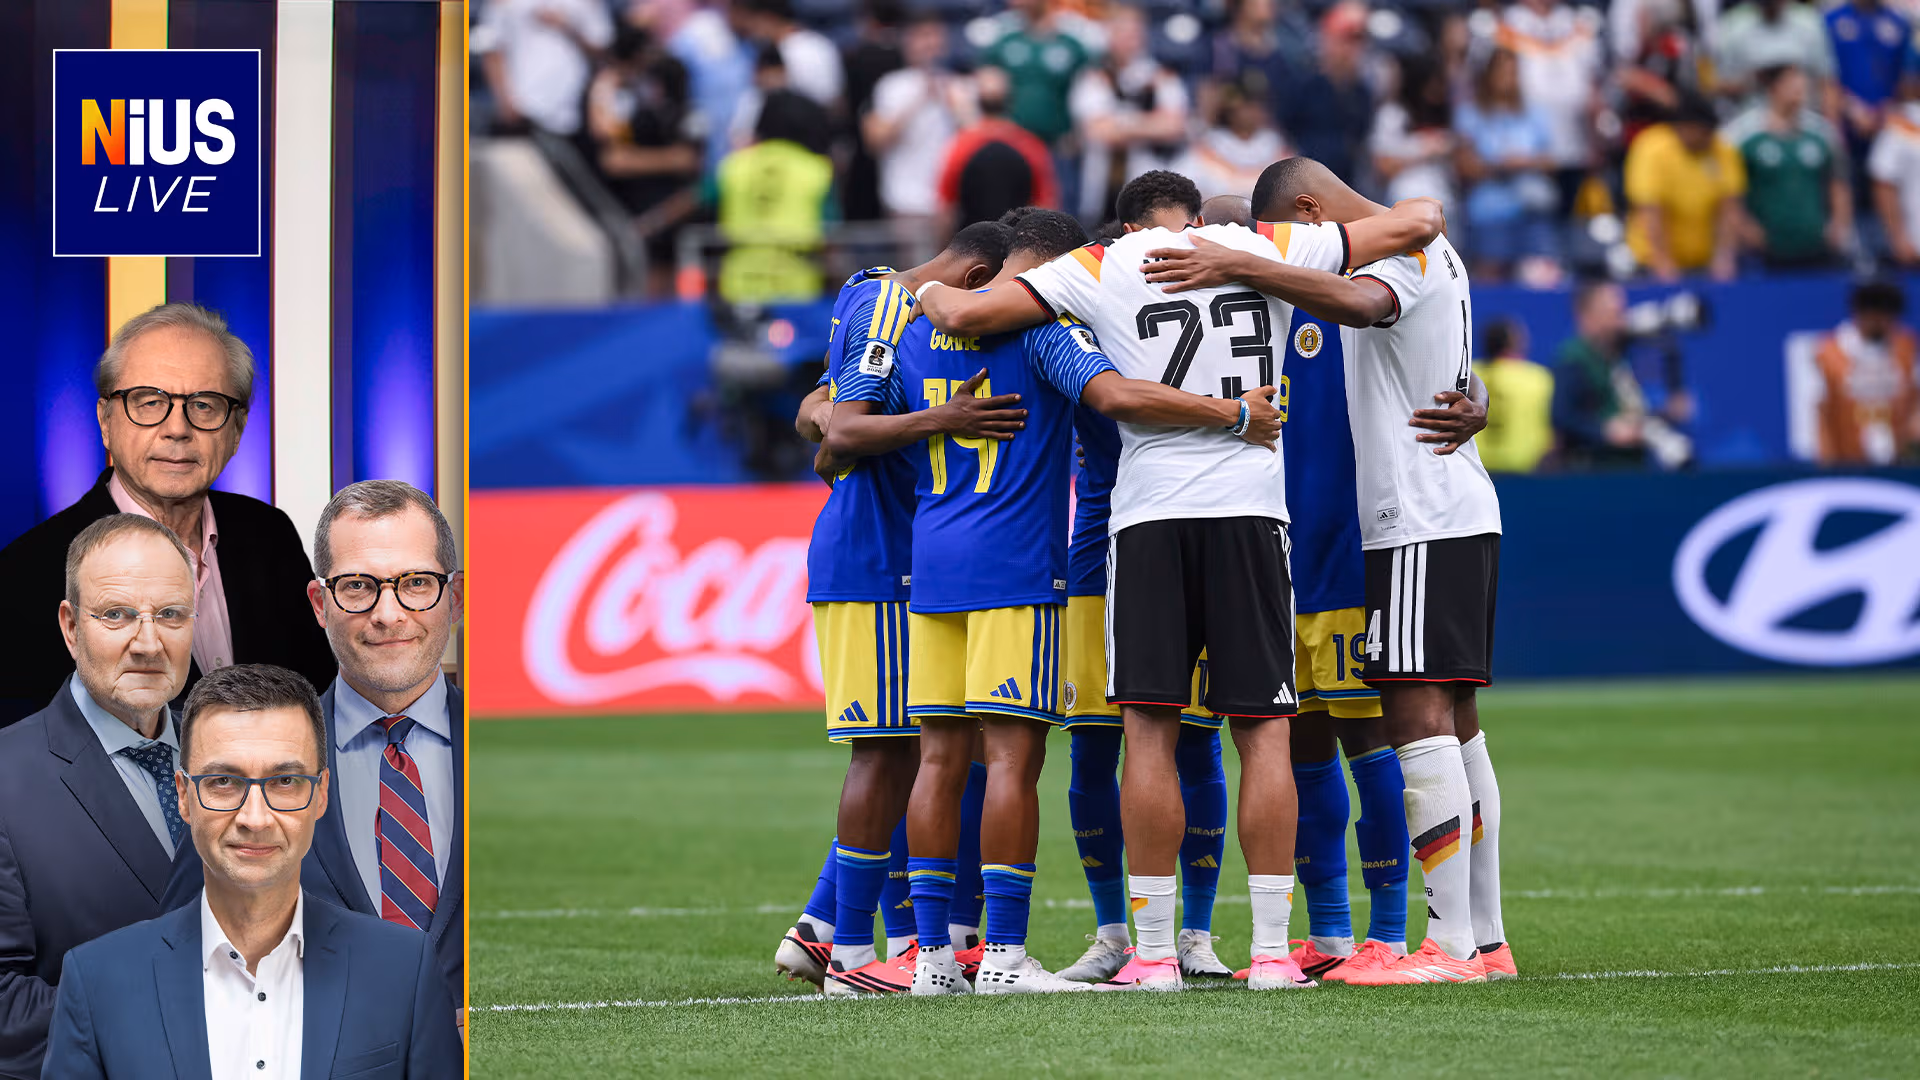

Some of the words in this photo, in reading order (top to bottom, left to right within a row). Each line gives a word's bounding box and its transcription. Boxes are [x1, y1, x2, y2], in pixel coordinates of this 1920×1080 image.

[1135, 290, 1274, 403] 23
[521, 491, 825, 705] Coca
[1365, 609, 1382, 661] 4
[1332, 633, 1365, 681] 19
